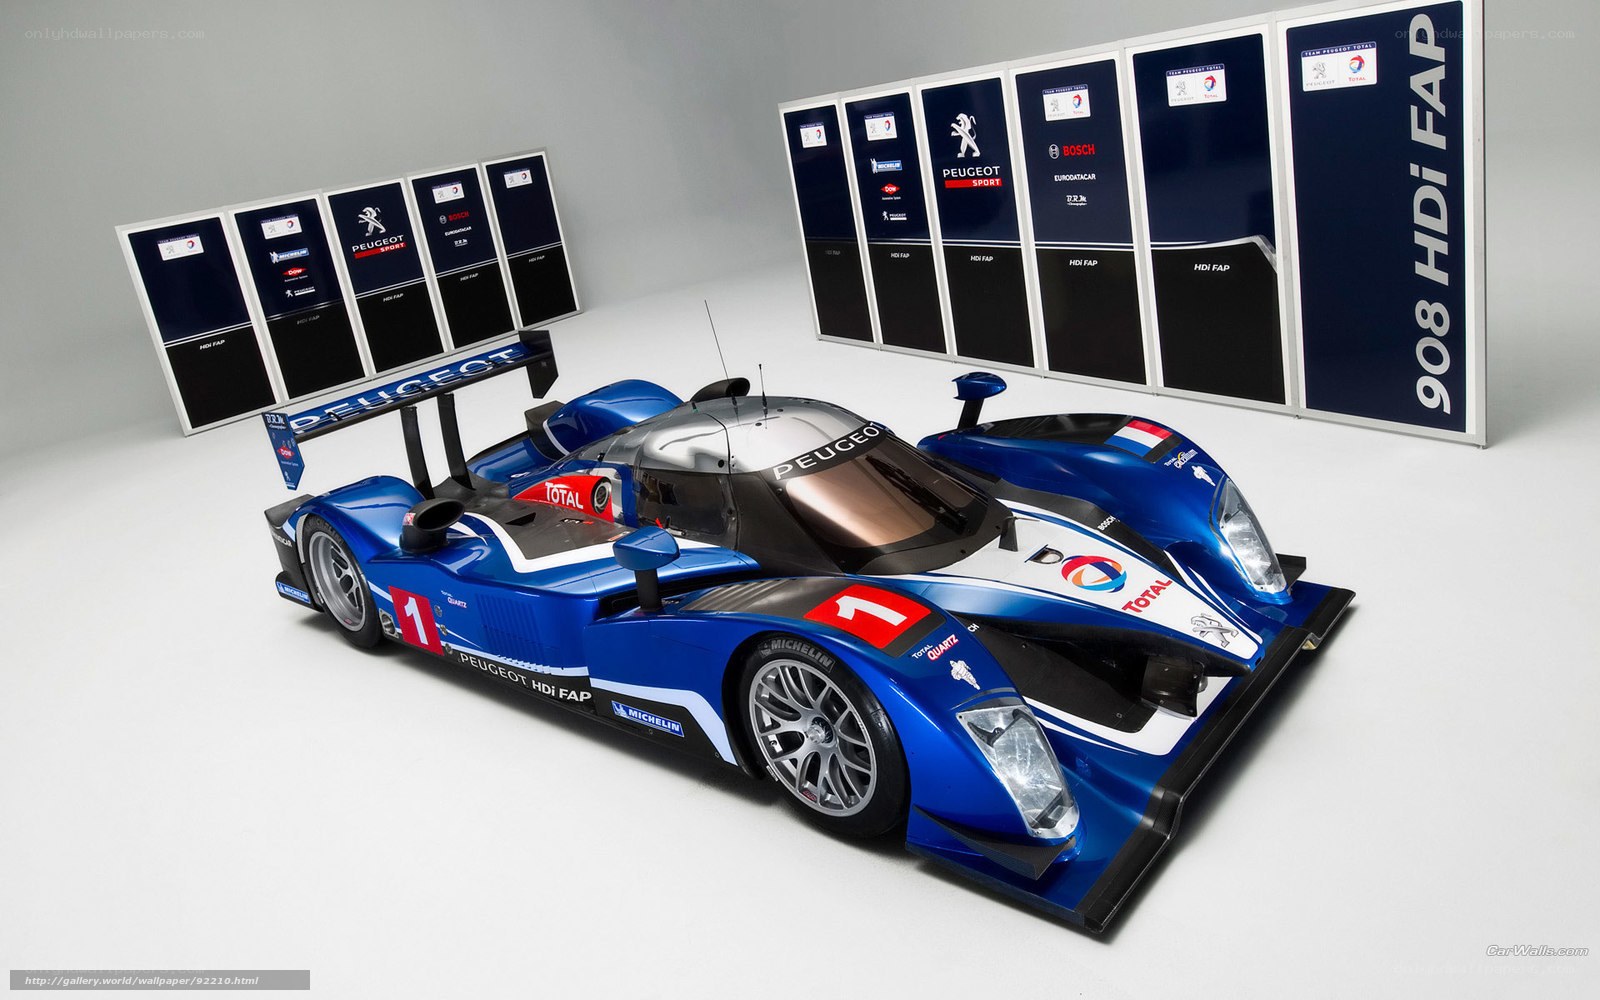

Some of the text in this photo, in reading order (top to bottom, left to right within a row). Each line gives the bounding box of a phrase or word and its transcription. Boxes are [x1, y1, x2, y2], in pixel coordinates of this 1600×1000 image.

[1322, 46, 1351, 54] PEUGEOT
[1063, 144, 1096, 156] BOSCH
[942, 166, 1000, 178] PEUGEOT
[1054, 174, 1096, 182] EURODATACAR
[972, 178, 1000, 186] SPORT
[448, 210, 470, 222] BOSCH
[1408, 13, 1451, 415] 908 HDi FAP
[352, 234, 404, 252] PEUGEOT
[380, 242, 404, 252] SPORT
[1212, 264, 1230, 272] FAP
[212, 339, 226, 347] FAP
[290, 349, 514, 434] PEUGEOT
[545, 482, 584, 510] TOTAL
[1097, 515, 1116, 530] BOSCH
[1121, 579, 1173, 613] TOTAL
[836, 595, 908, 626] 1
[404, 596, 429, 646] 1
[771, 639, 833, 668] MICHELIN
[912, 634, 959, 662] TOTAL QUARTZ
[460, 653, 592, 702] PEUGEOT HDi FAP
[628, 708, 680, 732] MICHELIN
